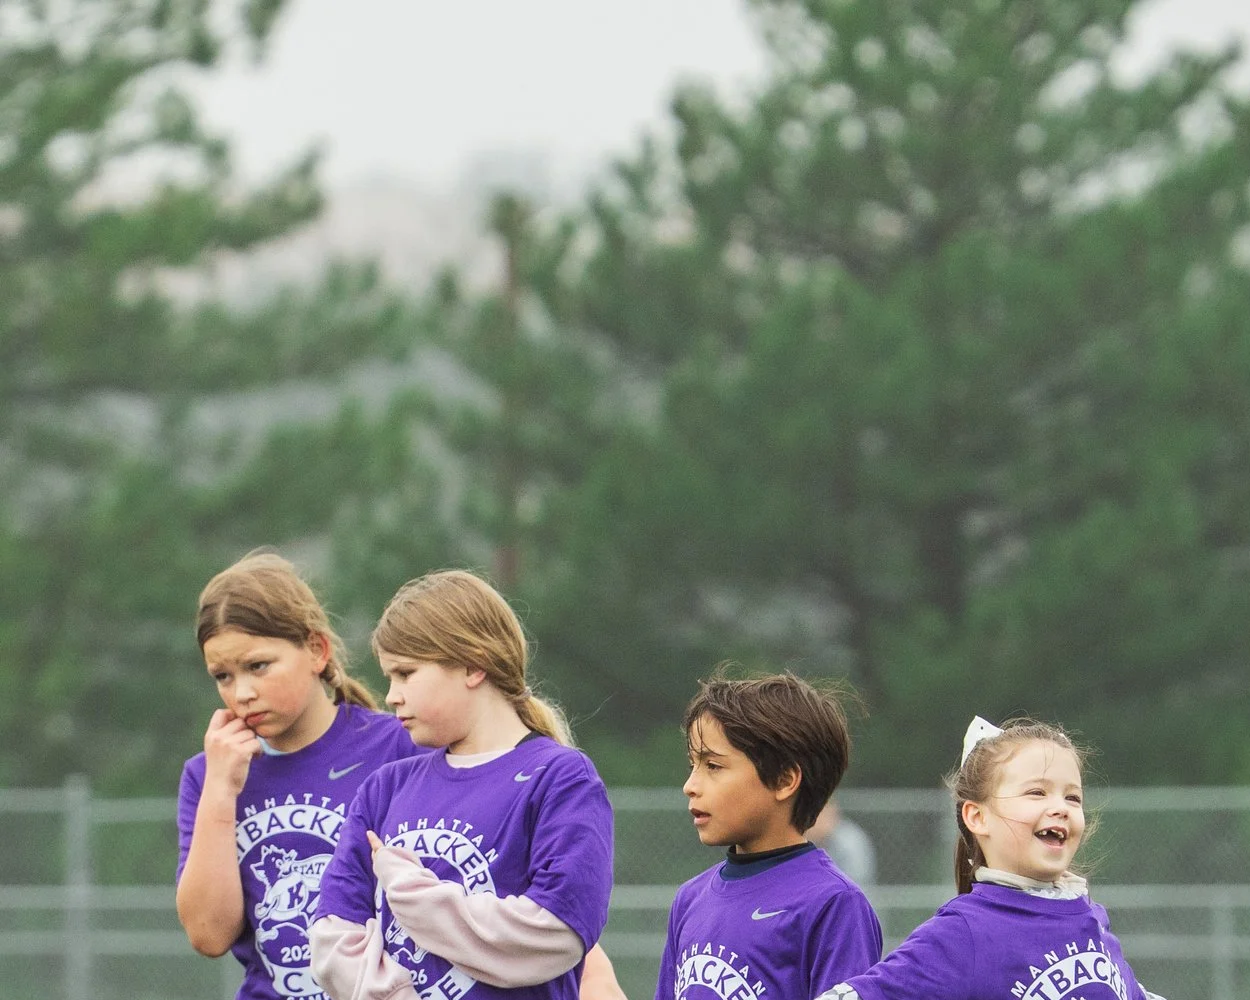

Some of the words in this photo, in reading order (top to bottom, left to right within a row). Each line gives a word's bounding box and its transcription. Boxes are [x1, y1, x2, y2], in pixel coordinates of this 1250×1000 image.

[243, 793, 346, 818] NHATTA
[384, 818, 499, 863] ANHATTAN
[281, 944, 312, 963] 202
